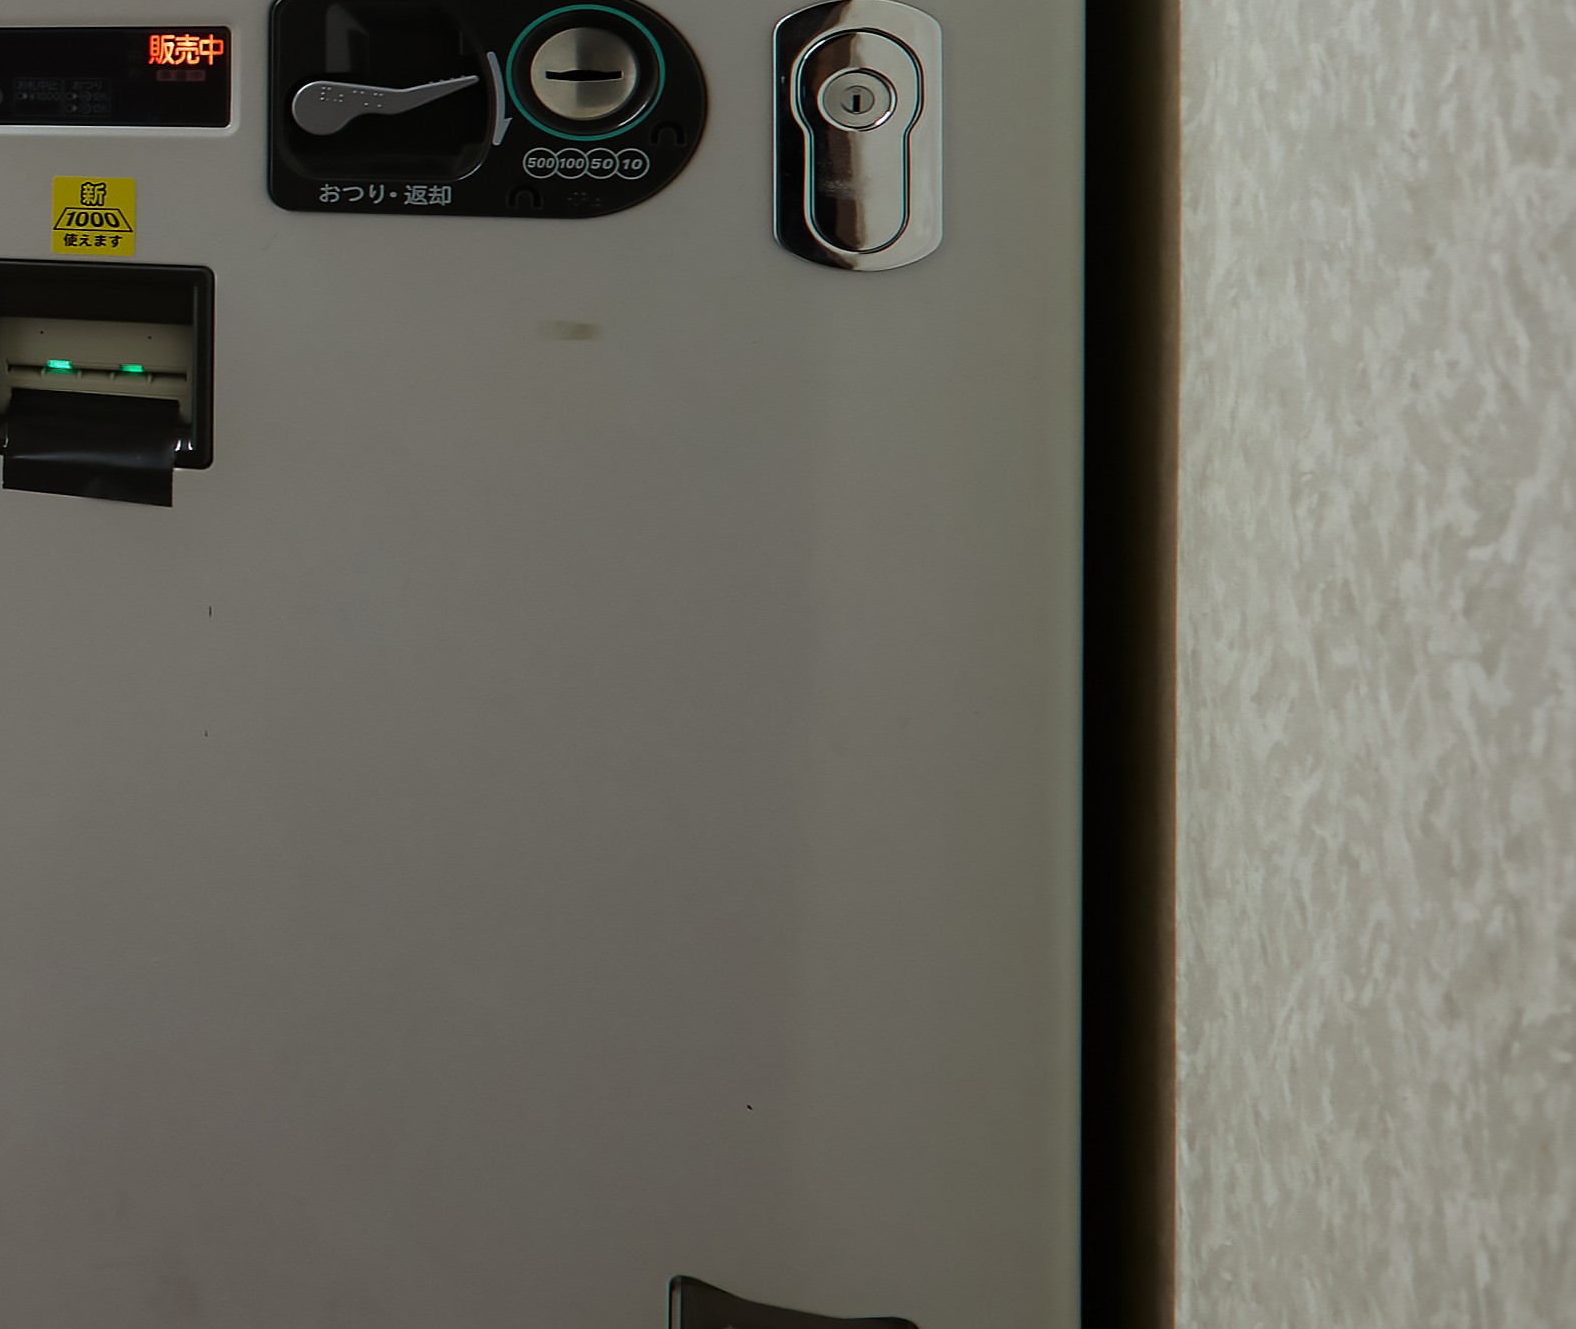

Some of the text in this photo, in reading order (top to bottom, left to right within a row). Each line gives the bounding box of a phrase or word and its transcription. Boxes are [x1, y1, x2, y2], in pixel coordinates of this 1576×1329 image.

[148, 33, 225, 66] 販売中
[526, 155, 643, 171] 500 100 50 10
[80, 181, 107, 207] 新
[318, 183, 453, 208] おつり・返却
[64, 210, 121, 231] 1000
[63, 232, 123, 249] 使えます
